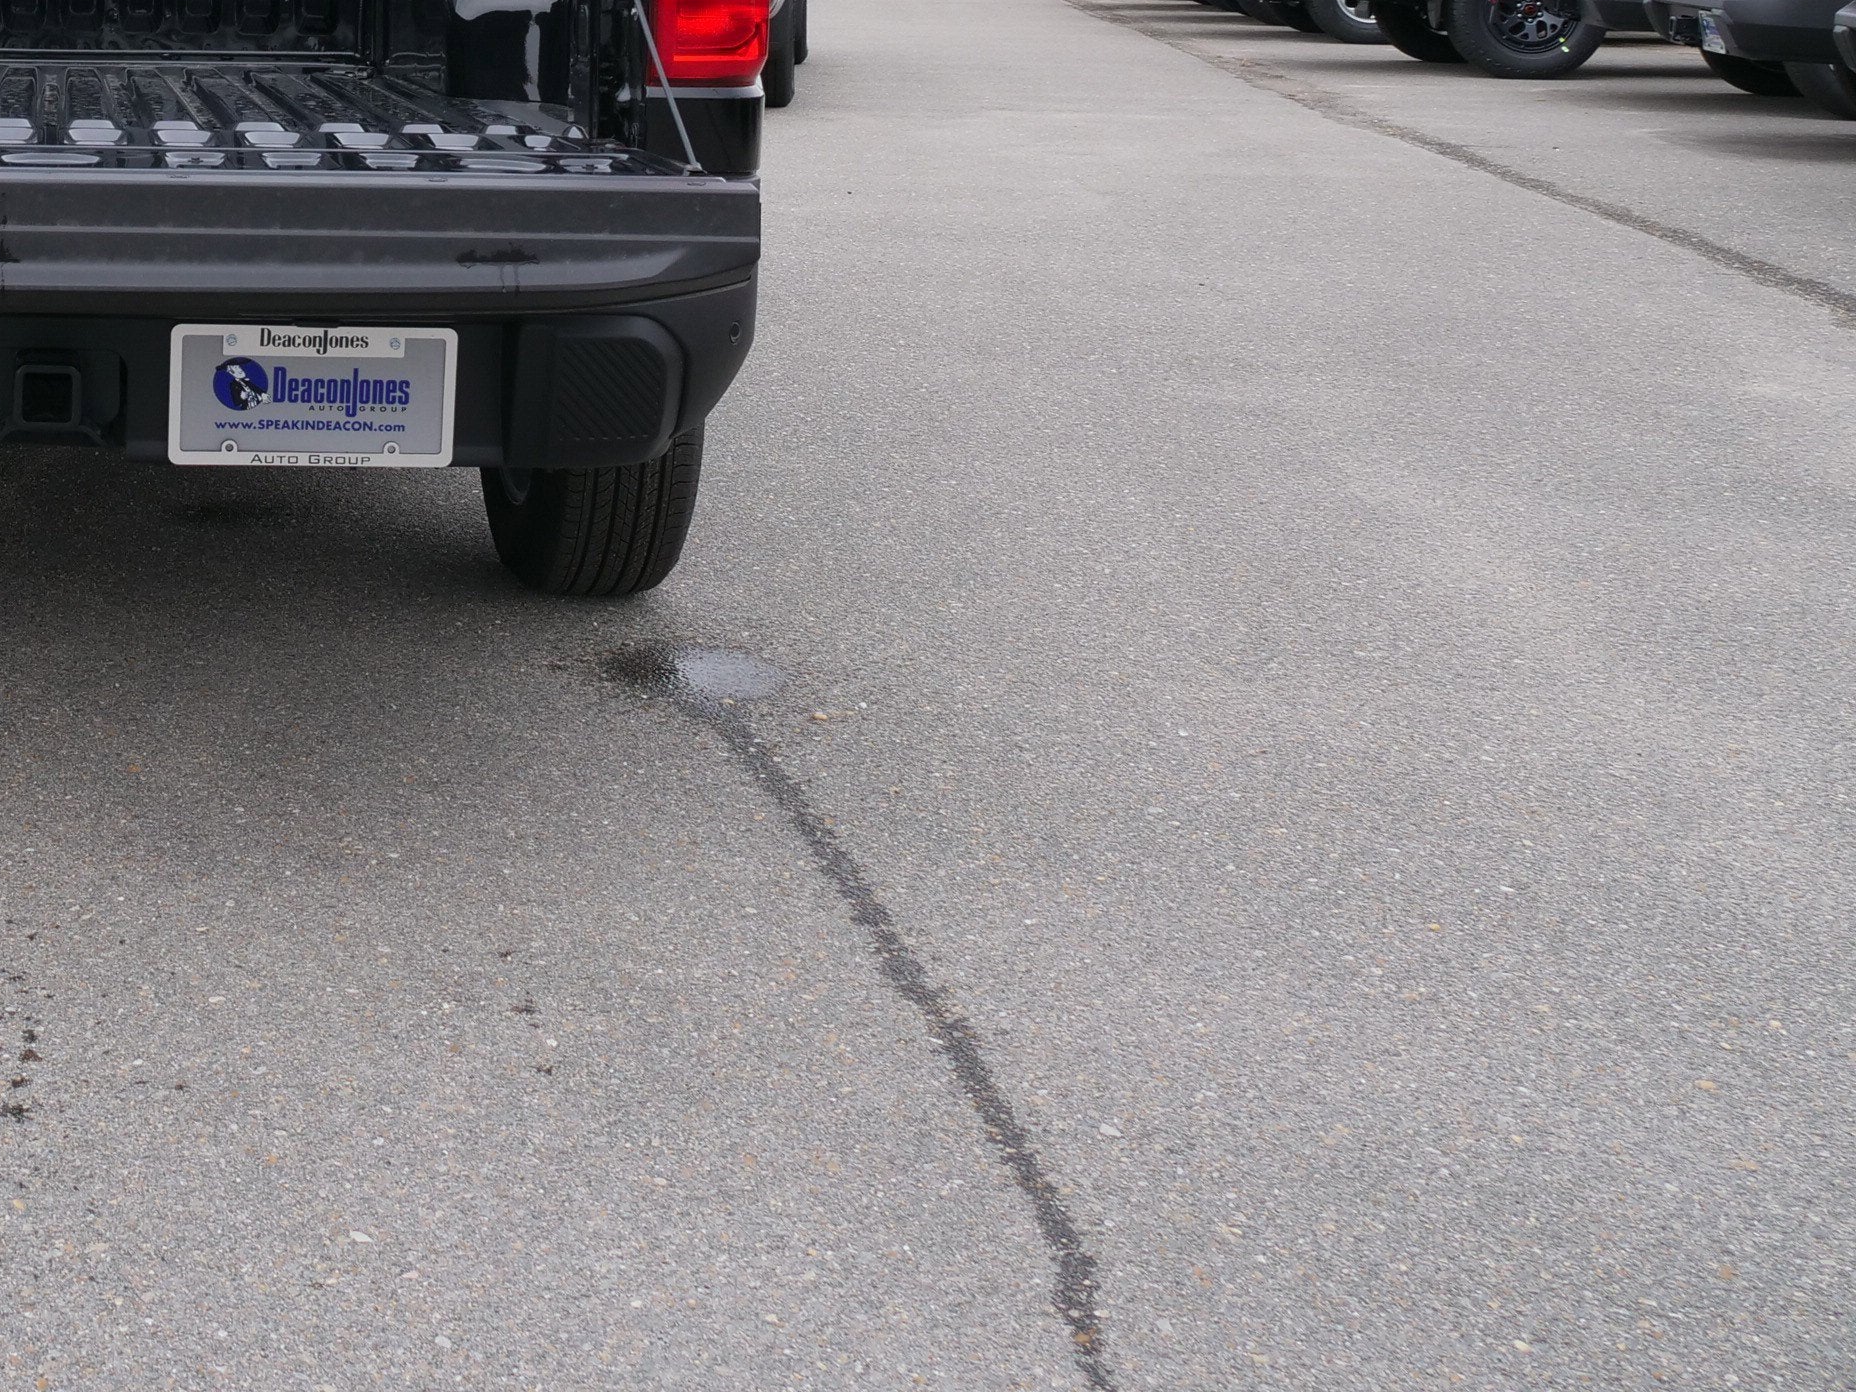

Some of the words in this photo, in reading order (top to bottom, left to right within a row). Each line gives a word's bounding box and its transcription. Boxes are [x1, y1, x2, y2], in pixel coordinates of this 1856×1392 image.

[308, 405, 344, 413] AUTO
[359, 405, 408, 413] GROUP
[214, 419, 406, 433] www.SPEAKINDEACON.com
